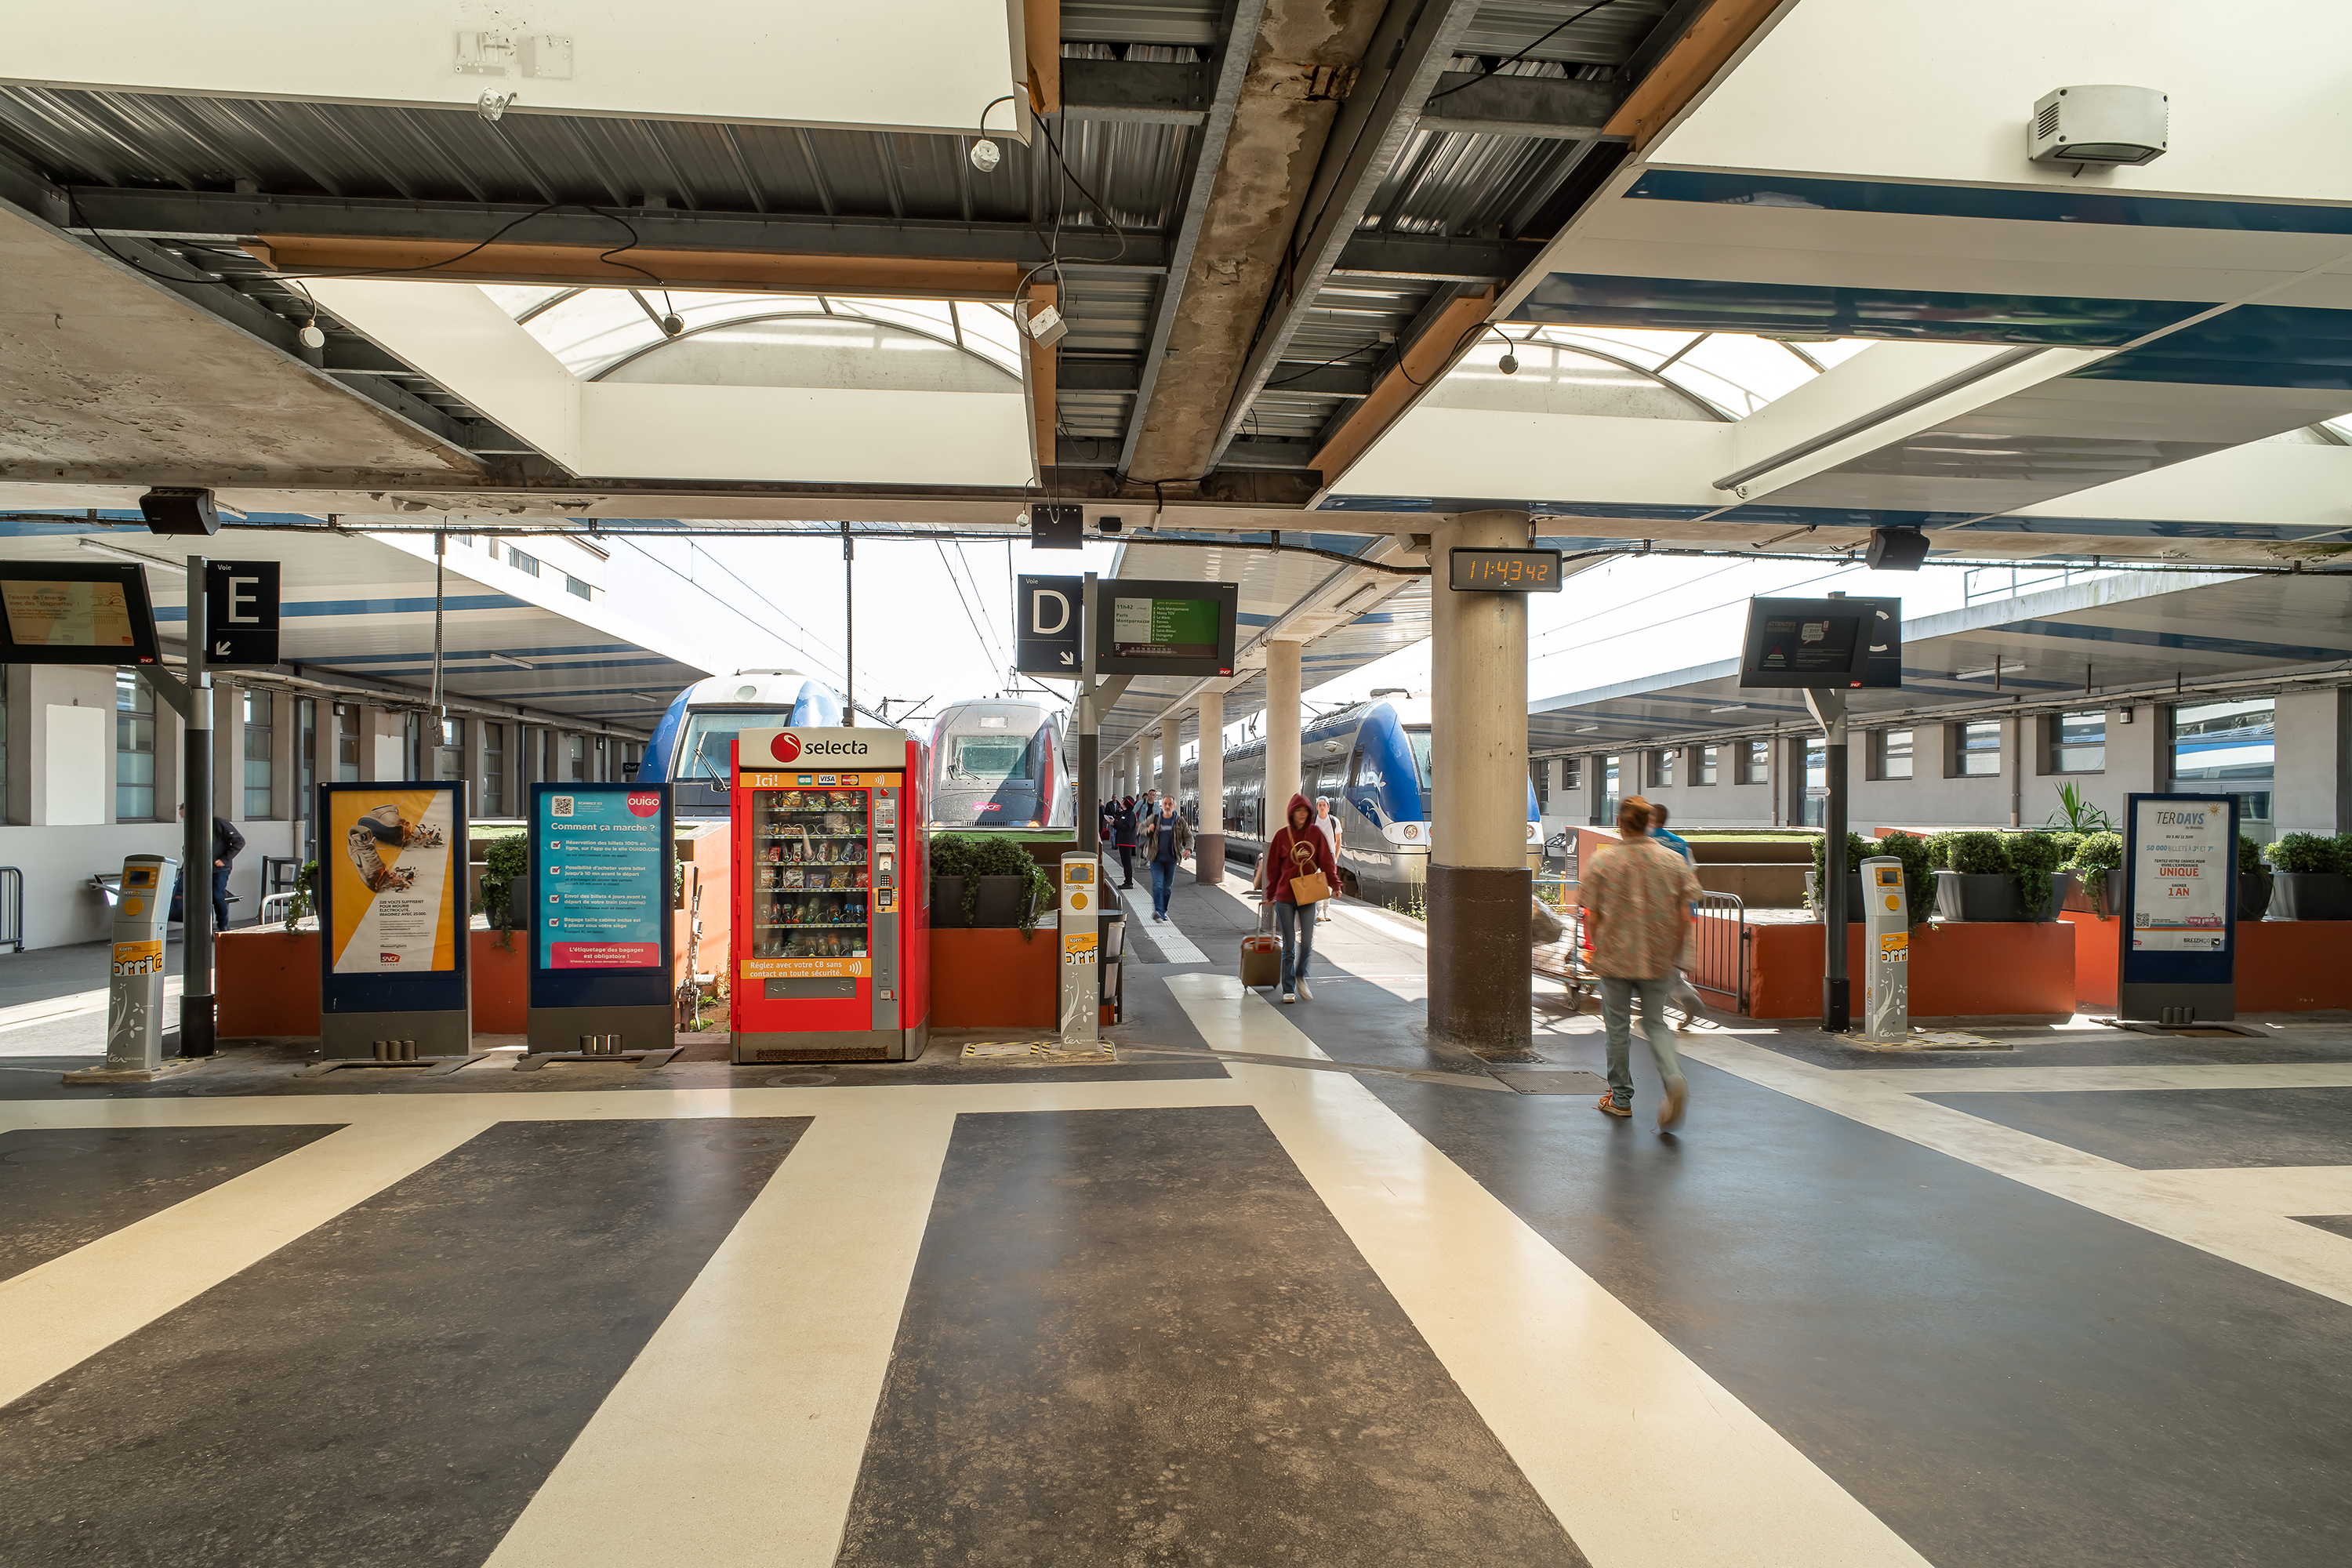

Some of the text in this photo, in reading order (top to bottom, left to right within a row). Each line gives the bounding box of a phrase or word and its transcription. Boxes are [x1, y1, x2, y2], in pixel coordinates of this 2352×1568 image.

[1470, 560, 1548, 581] 11:43 42
[228, 576, 260, 622] E
[1033, 589, 1070, 634] D
[804, 740, 869, 755] selecta
[755, 775, 779, 786] Ici!
[550, 822, 597, 831] Comment
[2188, 844, 2192, 852] À
[2160, 867, 2199, 877] UNIQUE
[2168, 887, 2190, 896] 1 AN
[750, 961, 774, 971] Réglez
[1878, 1027, 1896, 1037] ter
[1062, 1033, 1082, 1044] ter
[107, 1051, 128, 1063] ter
